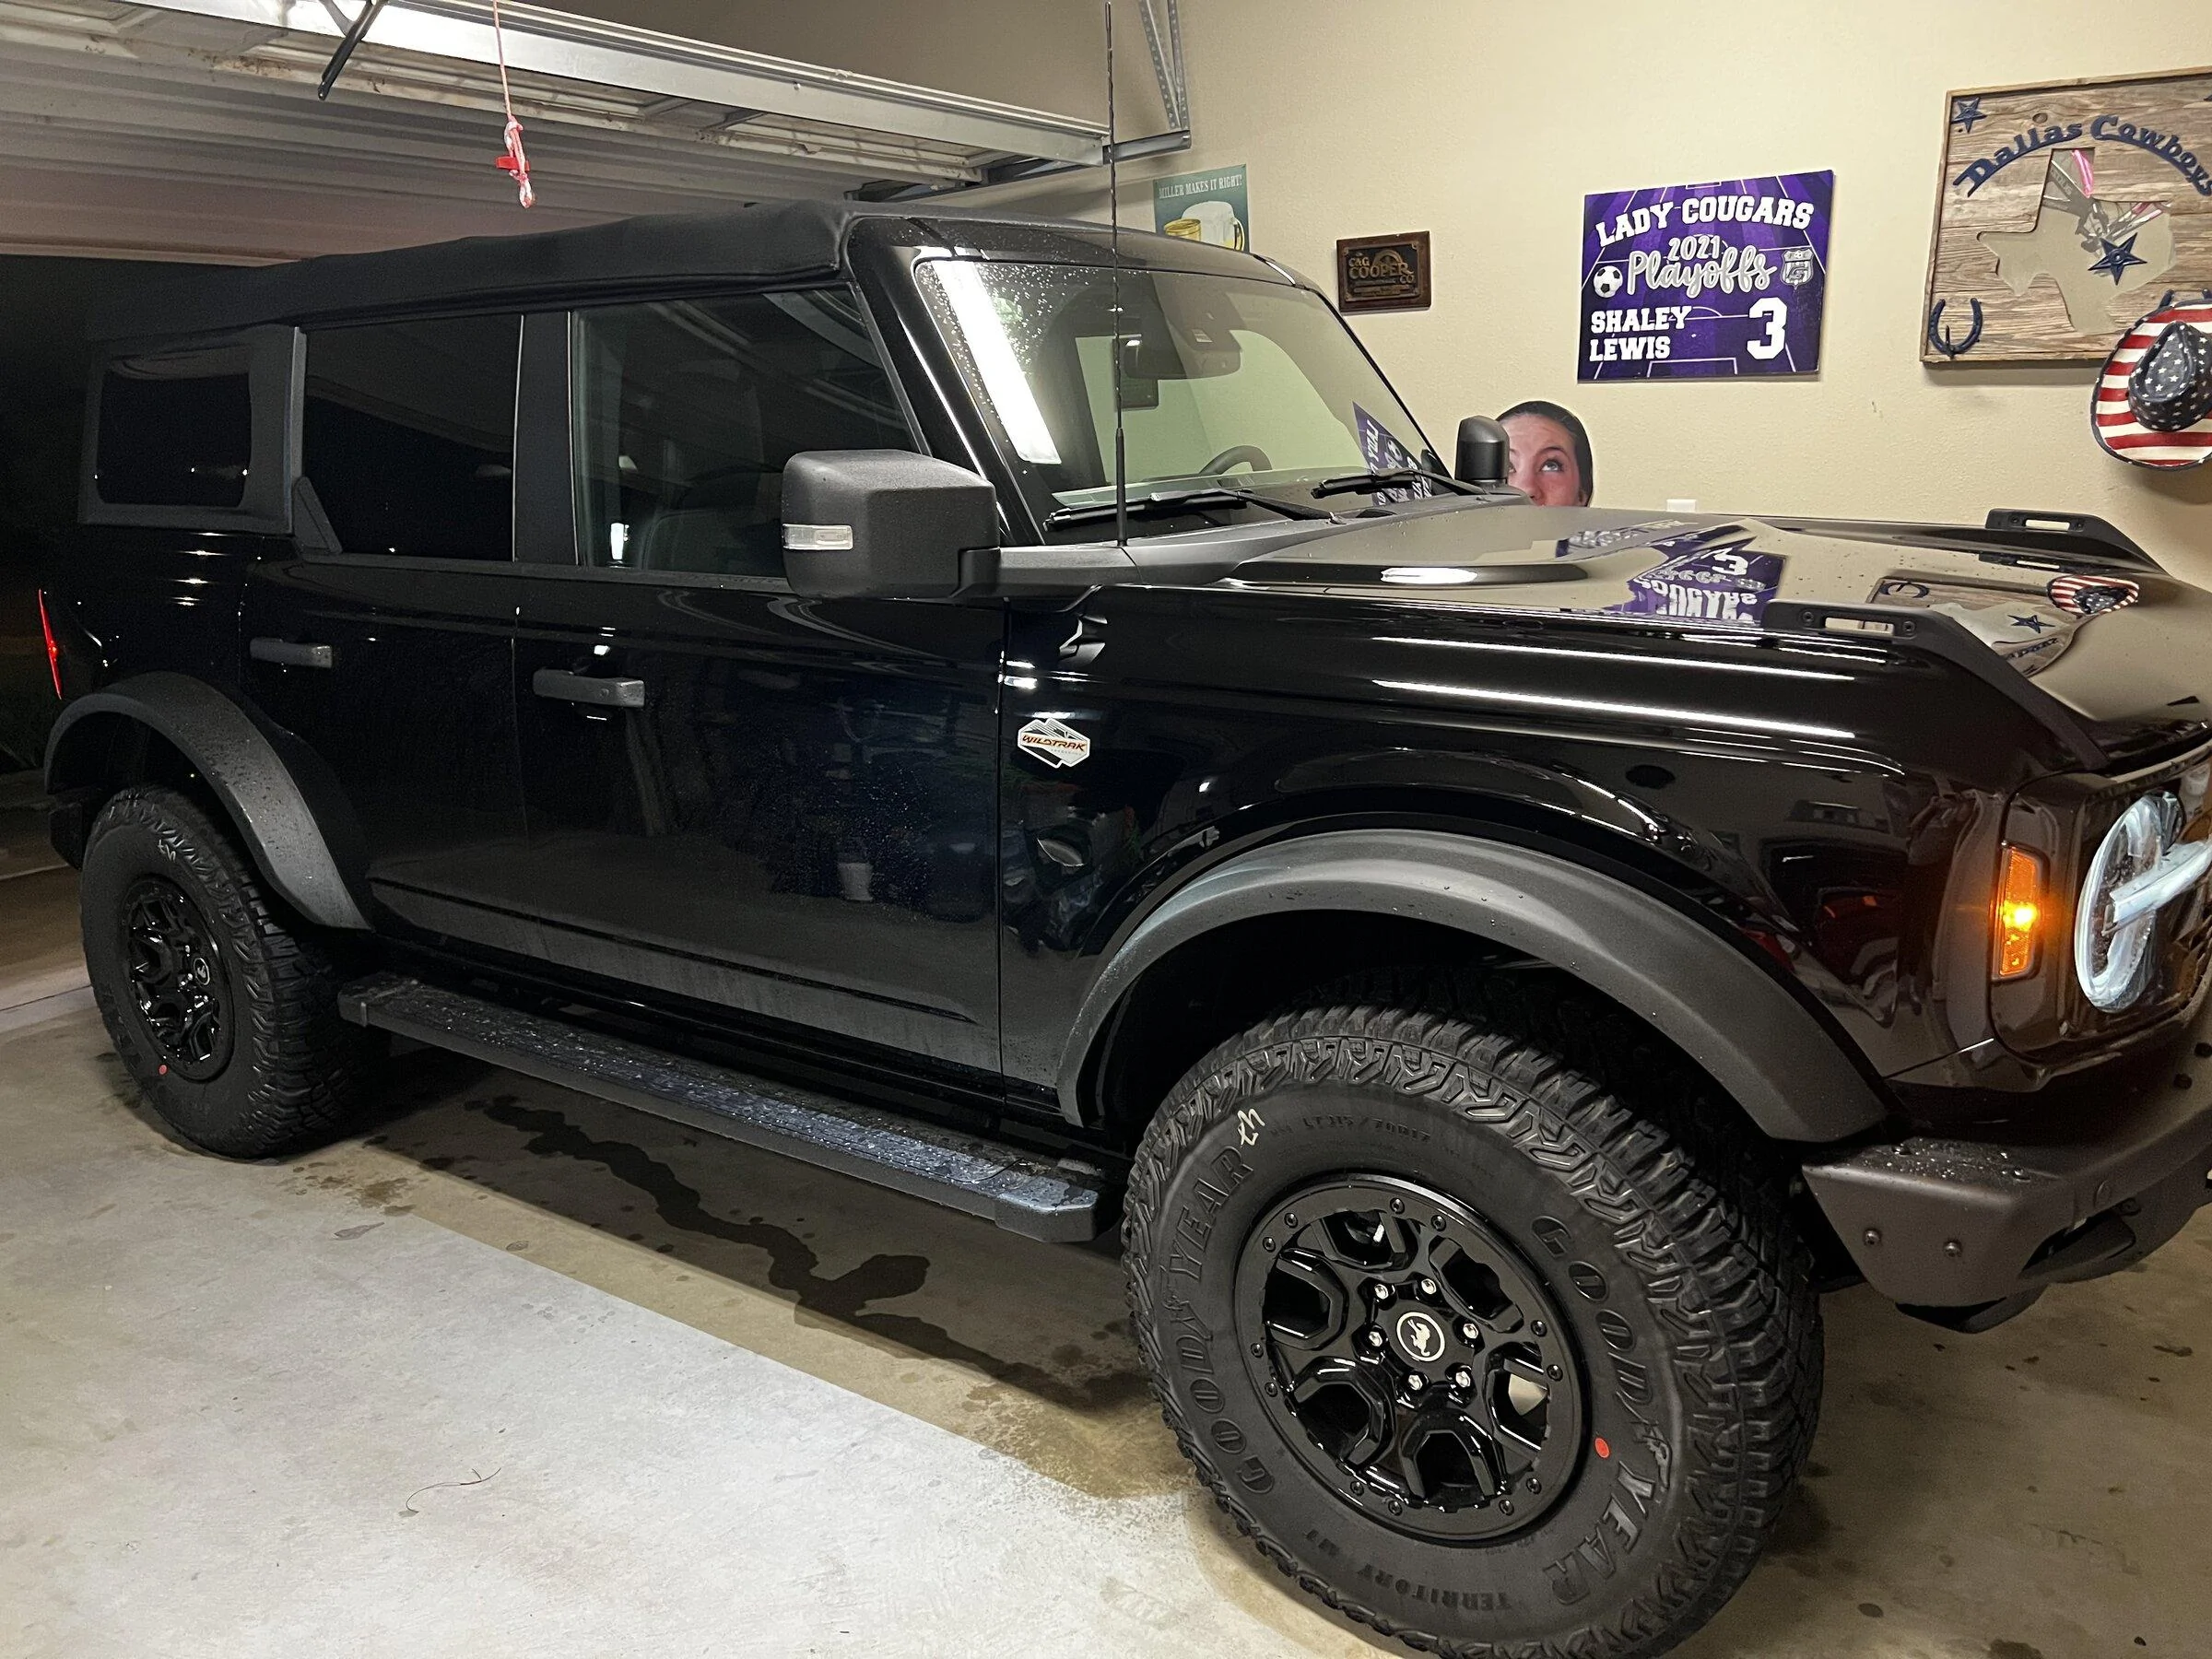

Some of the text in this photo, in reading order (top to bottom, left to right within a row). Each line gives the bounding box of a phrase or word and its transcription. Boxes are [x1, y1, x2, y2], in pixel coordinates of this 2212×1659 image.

[1952, 121, 2083, 197] Dallas
[1159, 184, 1184, 199] MILLER
[1185, 180, 1209, 195] MAKES
[1210, 179, 1218, 191] IT
[1595, 194, 1815, 247] LADY COUGARS
[1667, 235, 1721, 262] 2021
[1348, 262, 1415, 279] COOPER
[1627, 244, 1778, 298] Playoffs
[1590, 305, 1693, 334] SHALEY
[1747, 297, 1788, 359] 3
[1589, 335, 1671, 362] LEWIS
[1022, 735, 1087, 751] WILDTRAK
[1356, 1564, 1512, 1612] TERRITORY
